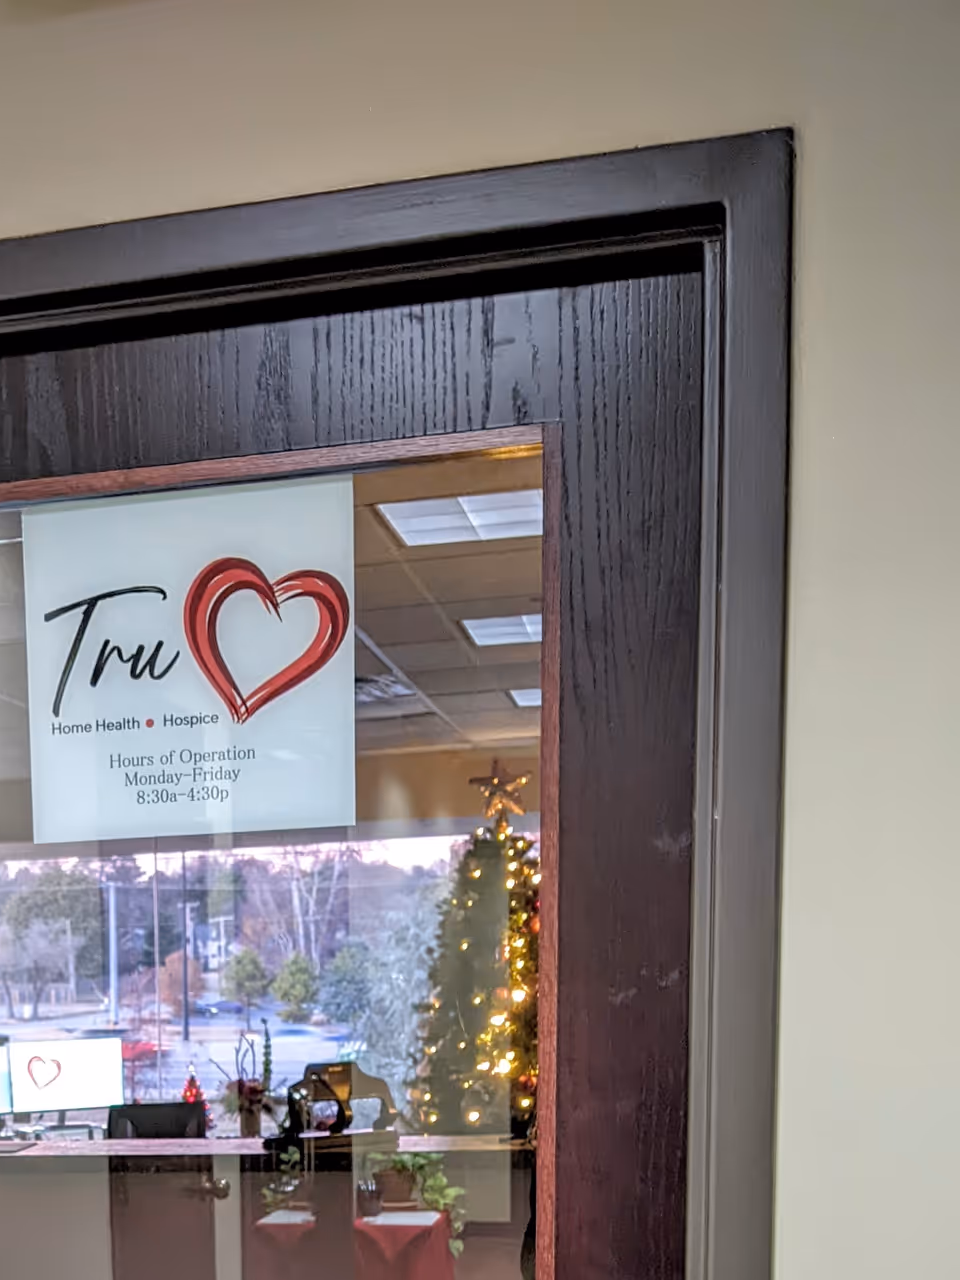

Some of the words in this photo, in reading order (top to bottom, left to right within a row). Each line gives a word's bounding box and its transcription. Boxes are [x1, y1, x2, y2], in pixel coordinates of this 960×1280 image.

[44, 586, 180, 717] Tru
[51, 721, 92, 735] Home
[95, 717, 140, 732] Health
[163, 712, 219, 728] Hospice
[109, 753, 154, 769] Hours
[160, 751, 176, 765] of
[179, 745, 256, 765] Operation
